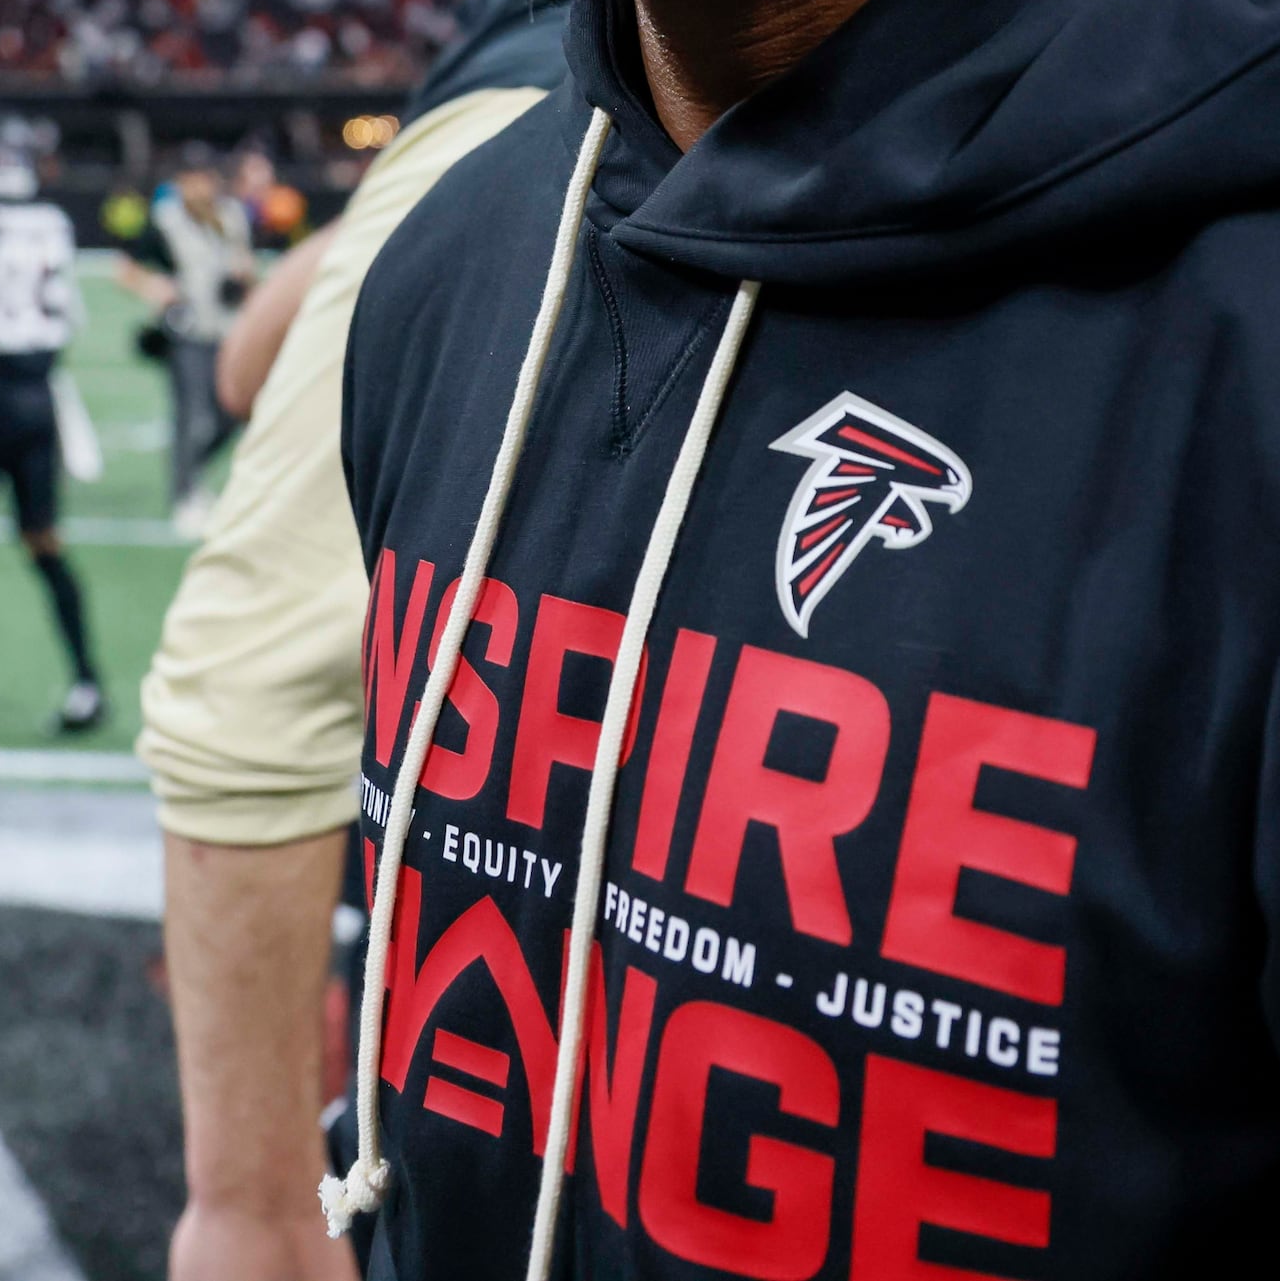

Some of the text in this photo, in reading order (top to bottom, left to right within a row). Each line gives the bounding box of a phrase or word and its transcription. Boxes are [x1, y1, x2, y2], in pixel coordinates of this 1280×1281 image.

[442, 823, 563, 898] EQUITY
[604, 881, 756, 987] FREEDOM
[816, 972, 1061, 1075] JUSTICE
